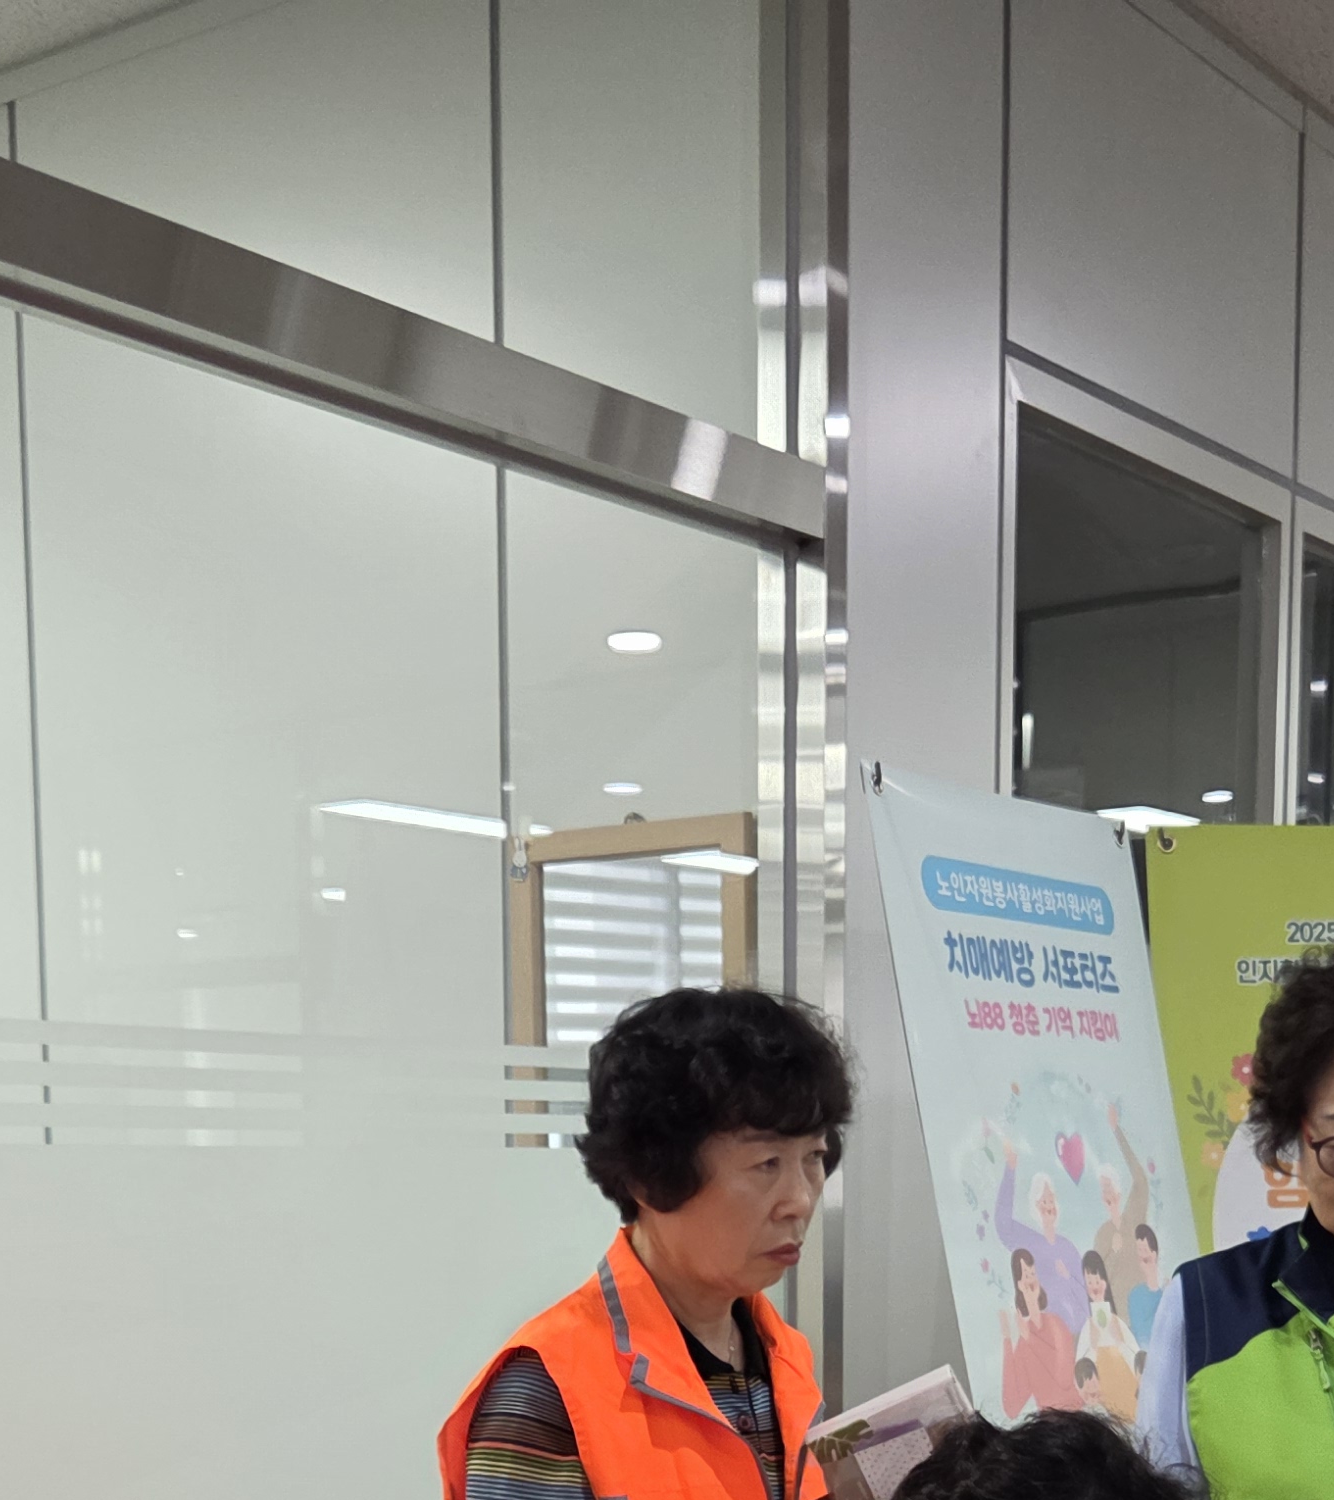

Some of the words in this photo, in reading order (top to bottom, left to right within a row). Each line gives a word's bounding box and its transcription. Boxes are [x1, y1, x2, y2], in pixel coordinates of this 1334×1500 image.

[935, 871, 1105, 926] 노인자원봉사활성화지원사업
[943, 930, 1036, 988] 치매예방
[1042, 945, 1120, 993] 서포터즈
[964, 998, 1006, 1031] 뇌88
[1008, 1001, 1041, 1037] 청춘
[1042, 1006, 1075, 1039] 기억
